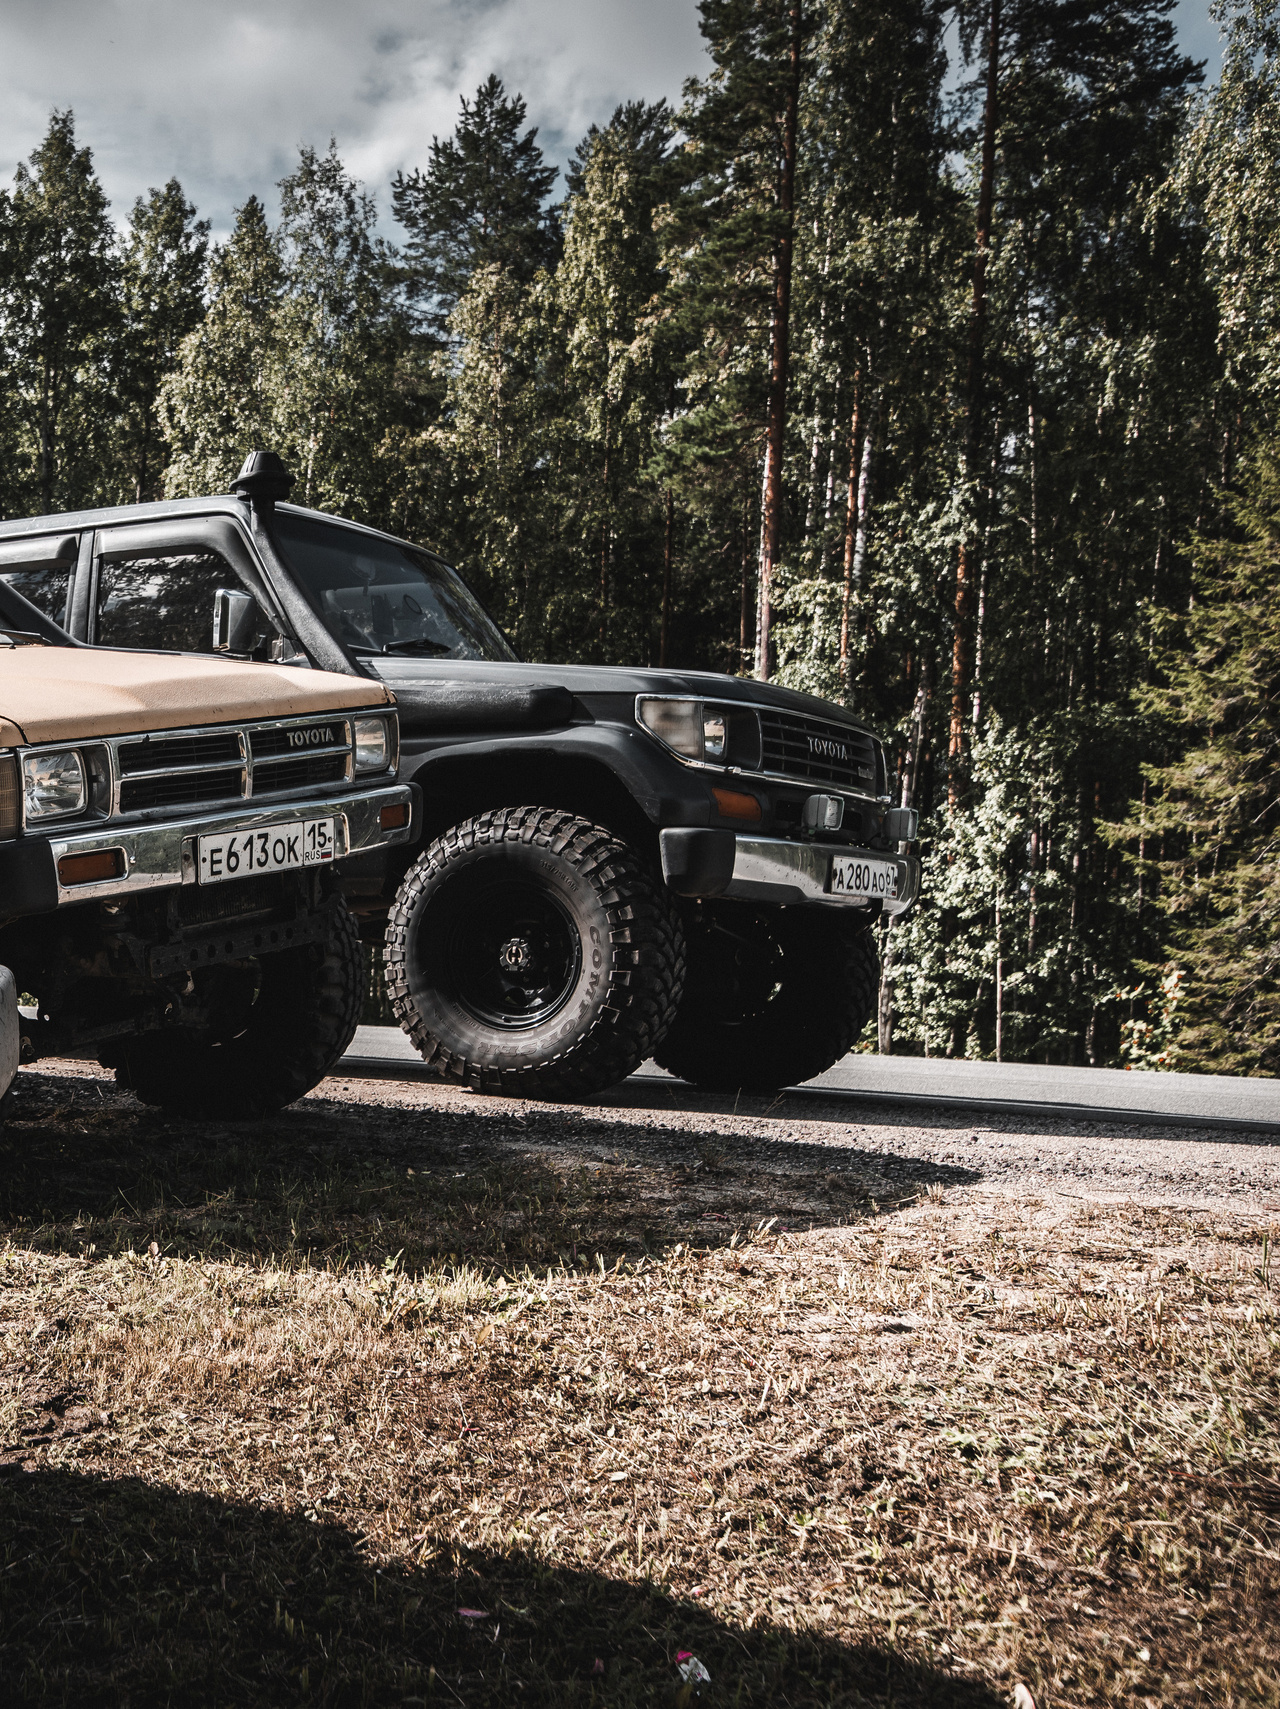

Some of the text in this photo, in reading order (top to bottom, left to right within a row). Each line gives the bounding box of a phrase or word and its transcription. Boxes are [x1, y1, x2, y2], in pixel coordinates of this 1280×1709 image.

[286, 727, 335, 747] TOYOTA
[806, 736, 848, 761] TOYOTA
[307, 822, 328, 849] 15
[305, 850, 321, 862] RUS
